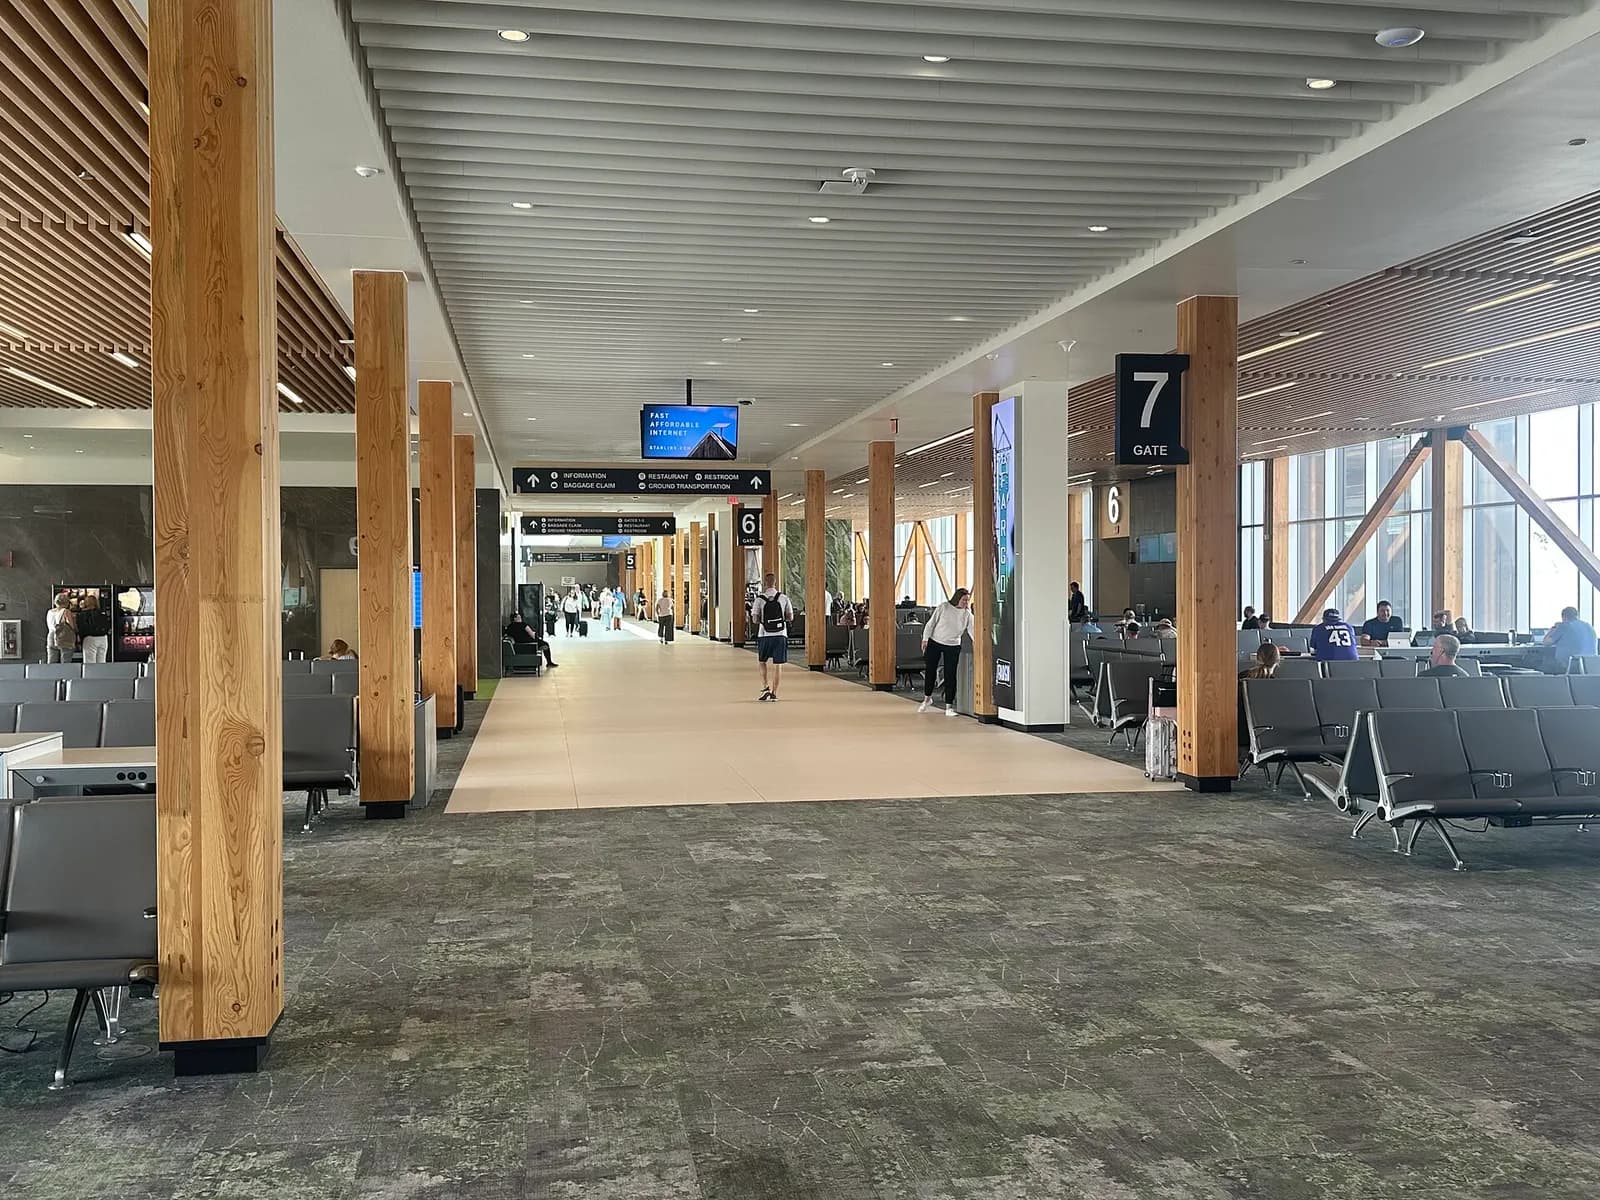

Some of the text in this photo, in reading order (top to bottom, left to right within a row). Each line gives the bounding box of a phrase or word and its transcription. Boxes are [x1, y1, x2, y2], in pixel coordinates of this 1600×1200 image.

[1134, 372, 1168, 428] 7
[649, 429, 688, 437] INTERNET
[1133, 445, 1168, 456] GATE
[1108, 486, 1119, 524] 6
[742, 513, 756, 534] 6
[626, 555, 634, 565] 5
[1329, 630, 1351, 646] 43
